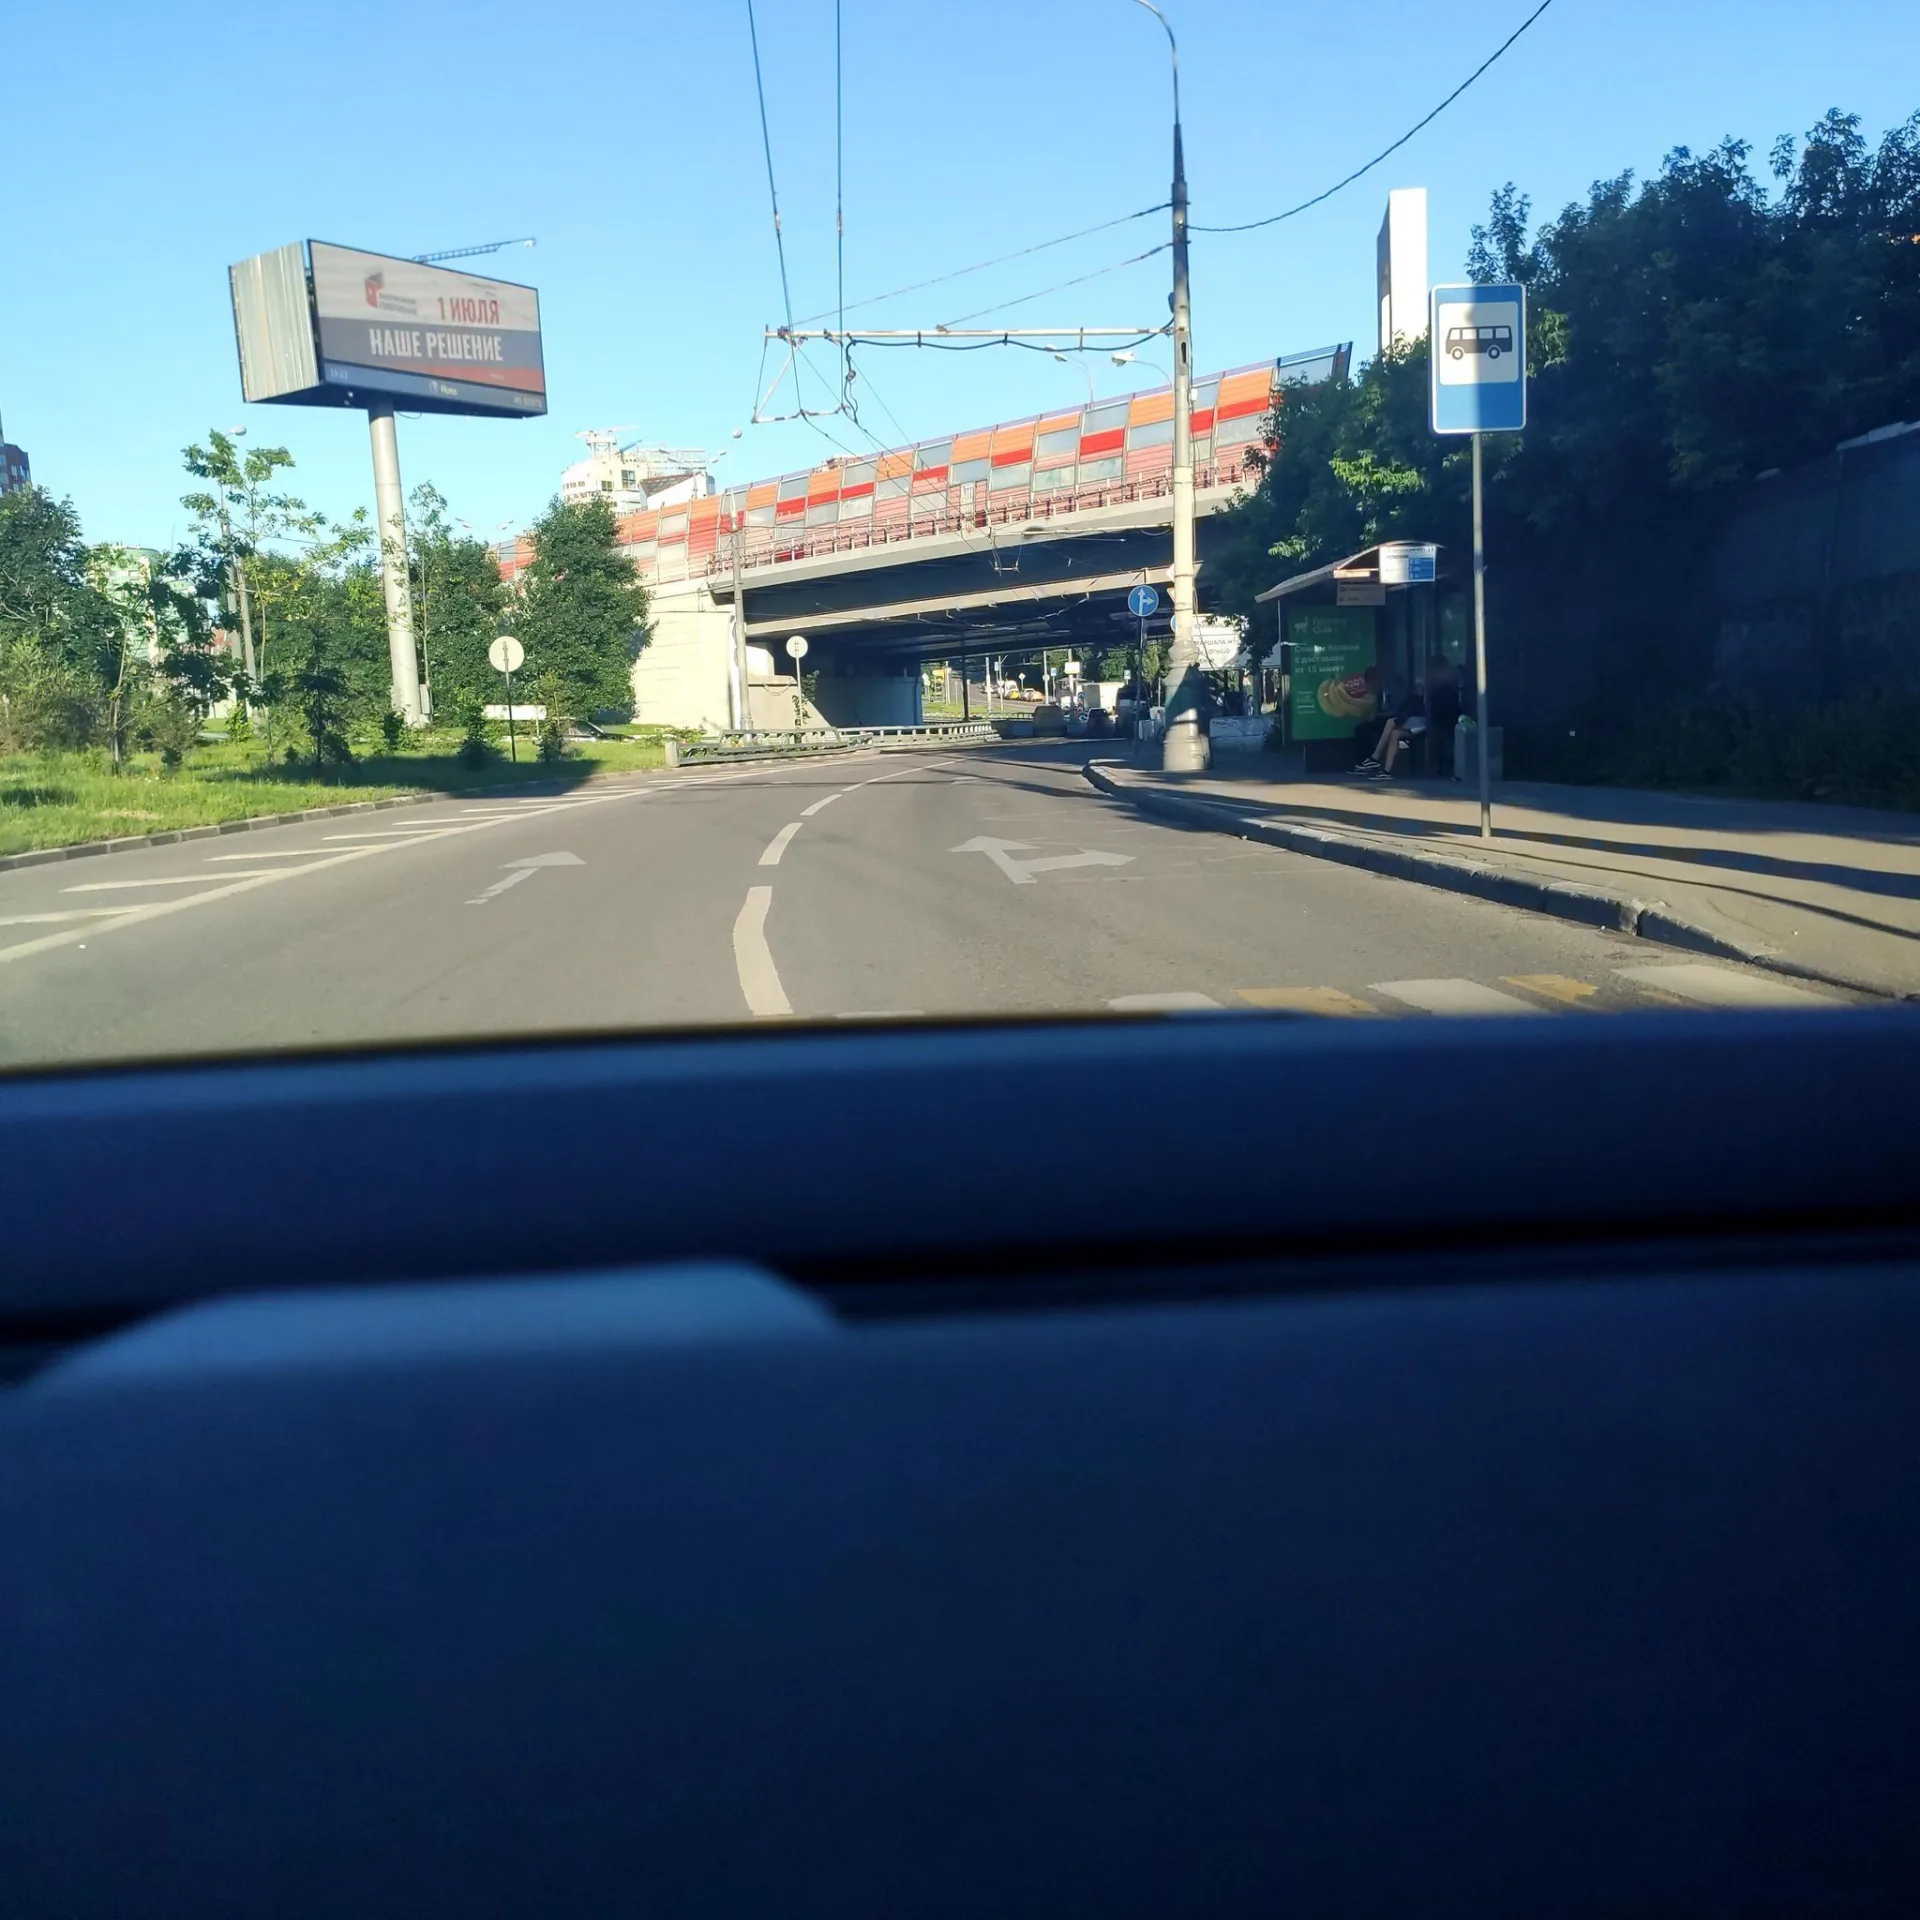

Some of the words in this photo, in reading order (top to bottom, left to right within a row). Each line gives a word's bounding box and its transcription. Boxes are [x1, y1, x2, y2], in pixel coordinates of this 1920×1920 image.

[437, 296, 446, 321] 1
[449, 297, 500, 324] ИЮЛЯ
[369, 328, 422, 358] НАШЕ
[425, 332, 504, 362] РЕШЕНИЕ
